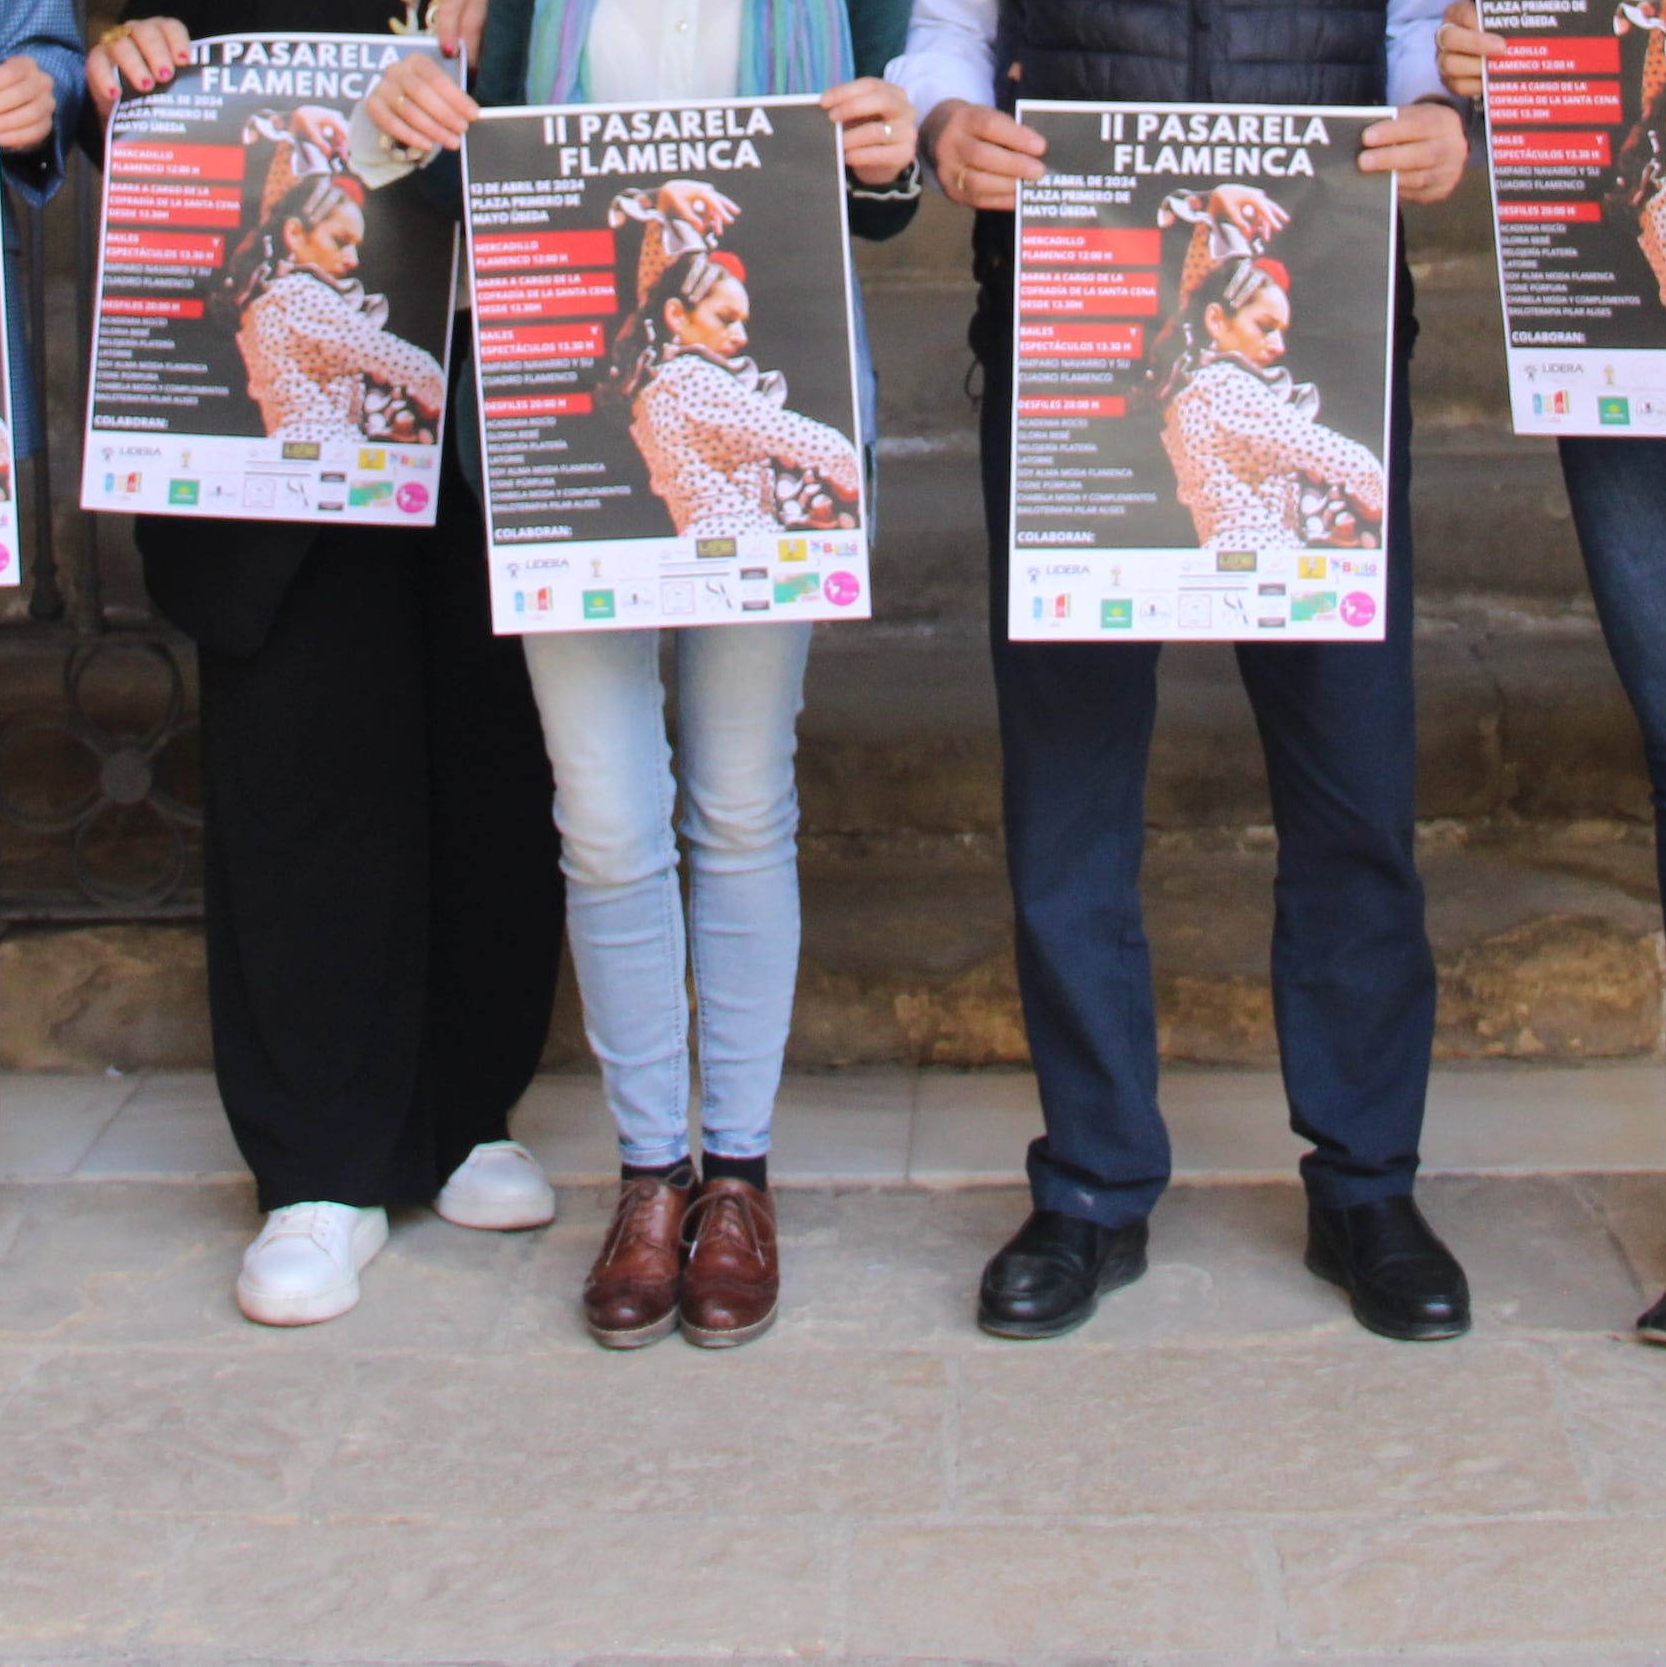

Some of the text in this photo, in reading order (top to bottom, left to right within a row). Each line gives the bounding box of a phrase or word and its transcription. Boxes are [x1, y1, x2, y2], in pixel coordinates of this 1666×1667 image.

[1483, 0, 1586, 12] PLAZA PRIMERO DE
[1484, 12, 1557, 27] MAYO ÚBEDA
[222, 41, 401, 71] PASARELA
[544, 105, 772, 145] II PASARELA
[1100, 113, 1329, 143] II PASARELA
[559, 139, 761, 176] FLAMENCA
[1113, 145, 1314, 176] FLAMENCA
[1022, 189, 1130, 203] PLAZA PRIMERO DE
[1021, 202, 1097, 217] MAYO ÚBEDA
[1511, 331, 1585, 343] COLABORAN:
